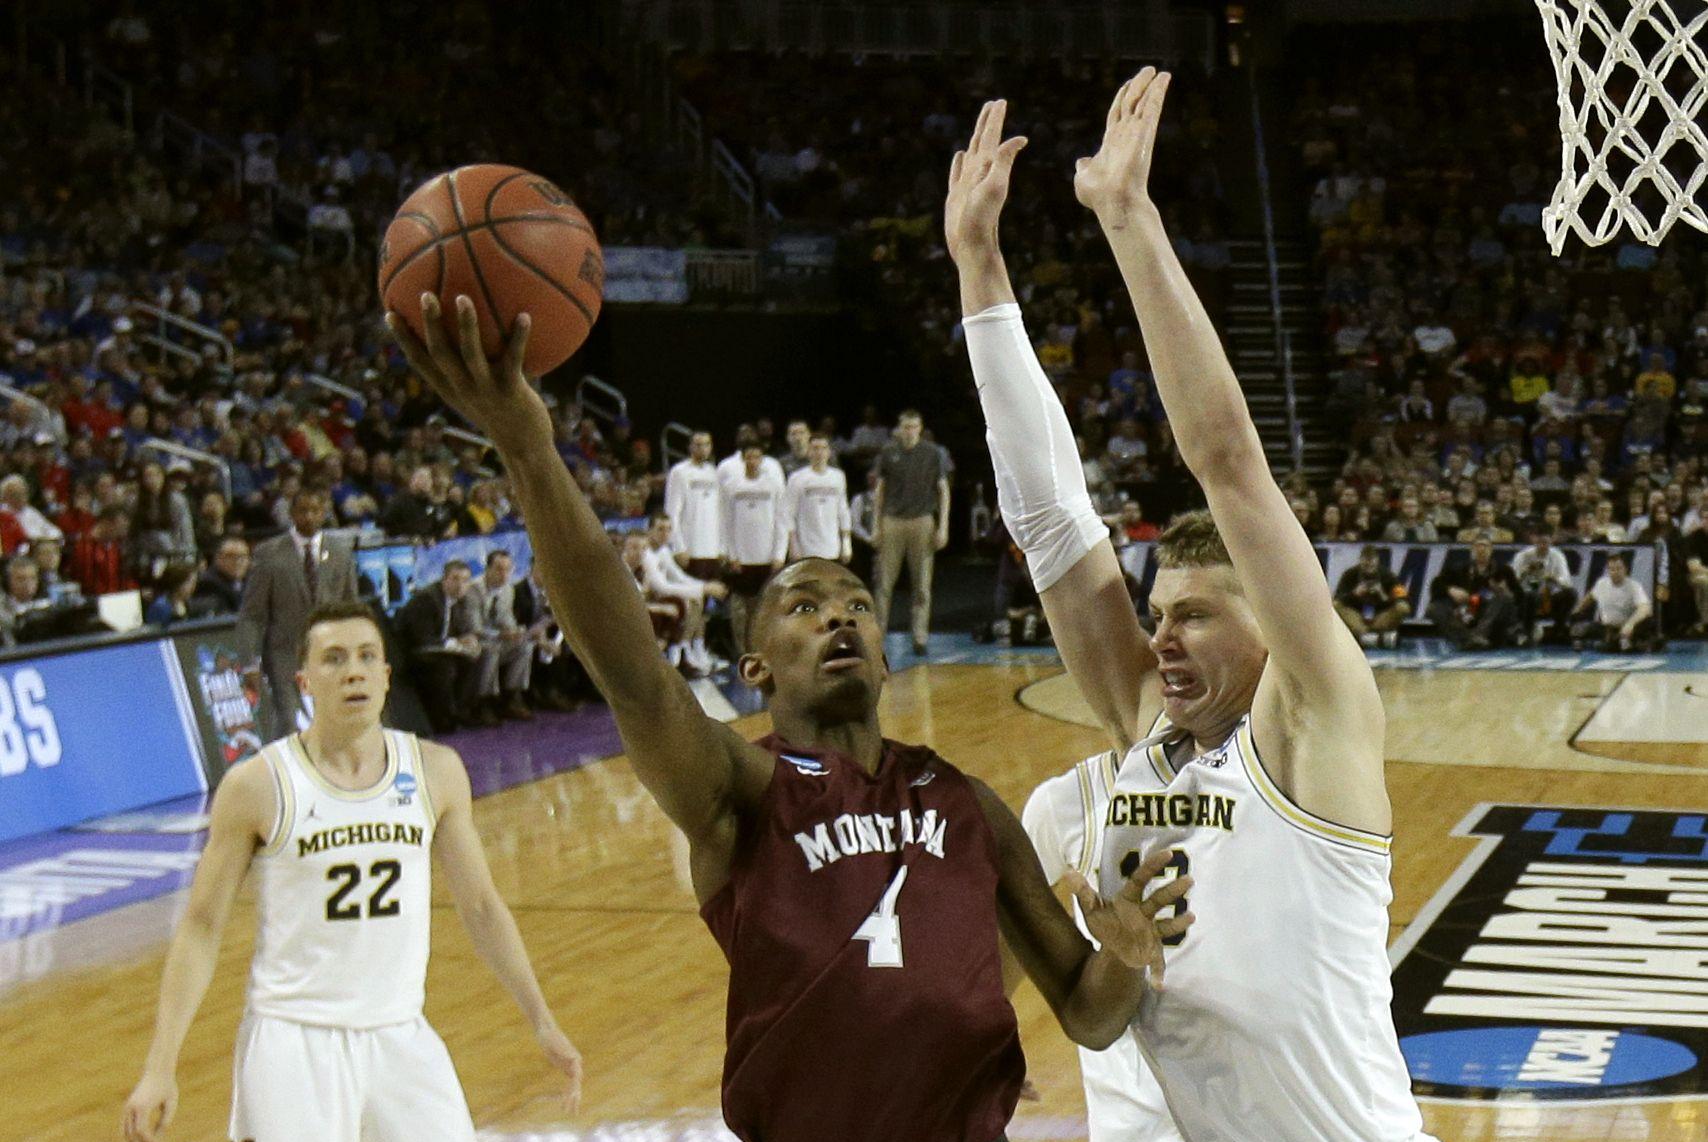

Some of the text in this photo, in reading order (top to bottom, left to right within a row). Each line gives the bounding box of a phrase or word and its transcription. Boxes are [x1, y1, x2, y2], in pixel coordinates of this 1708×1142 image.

[298, 822, 424, 857] MICHIGAN
[325, 858, 402, 921] 22
[851, 864, 907, 968] 4
[1516, 1029, 1621, 1085] NCAA
